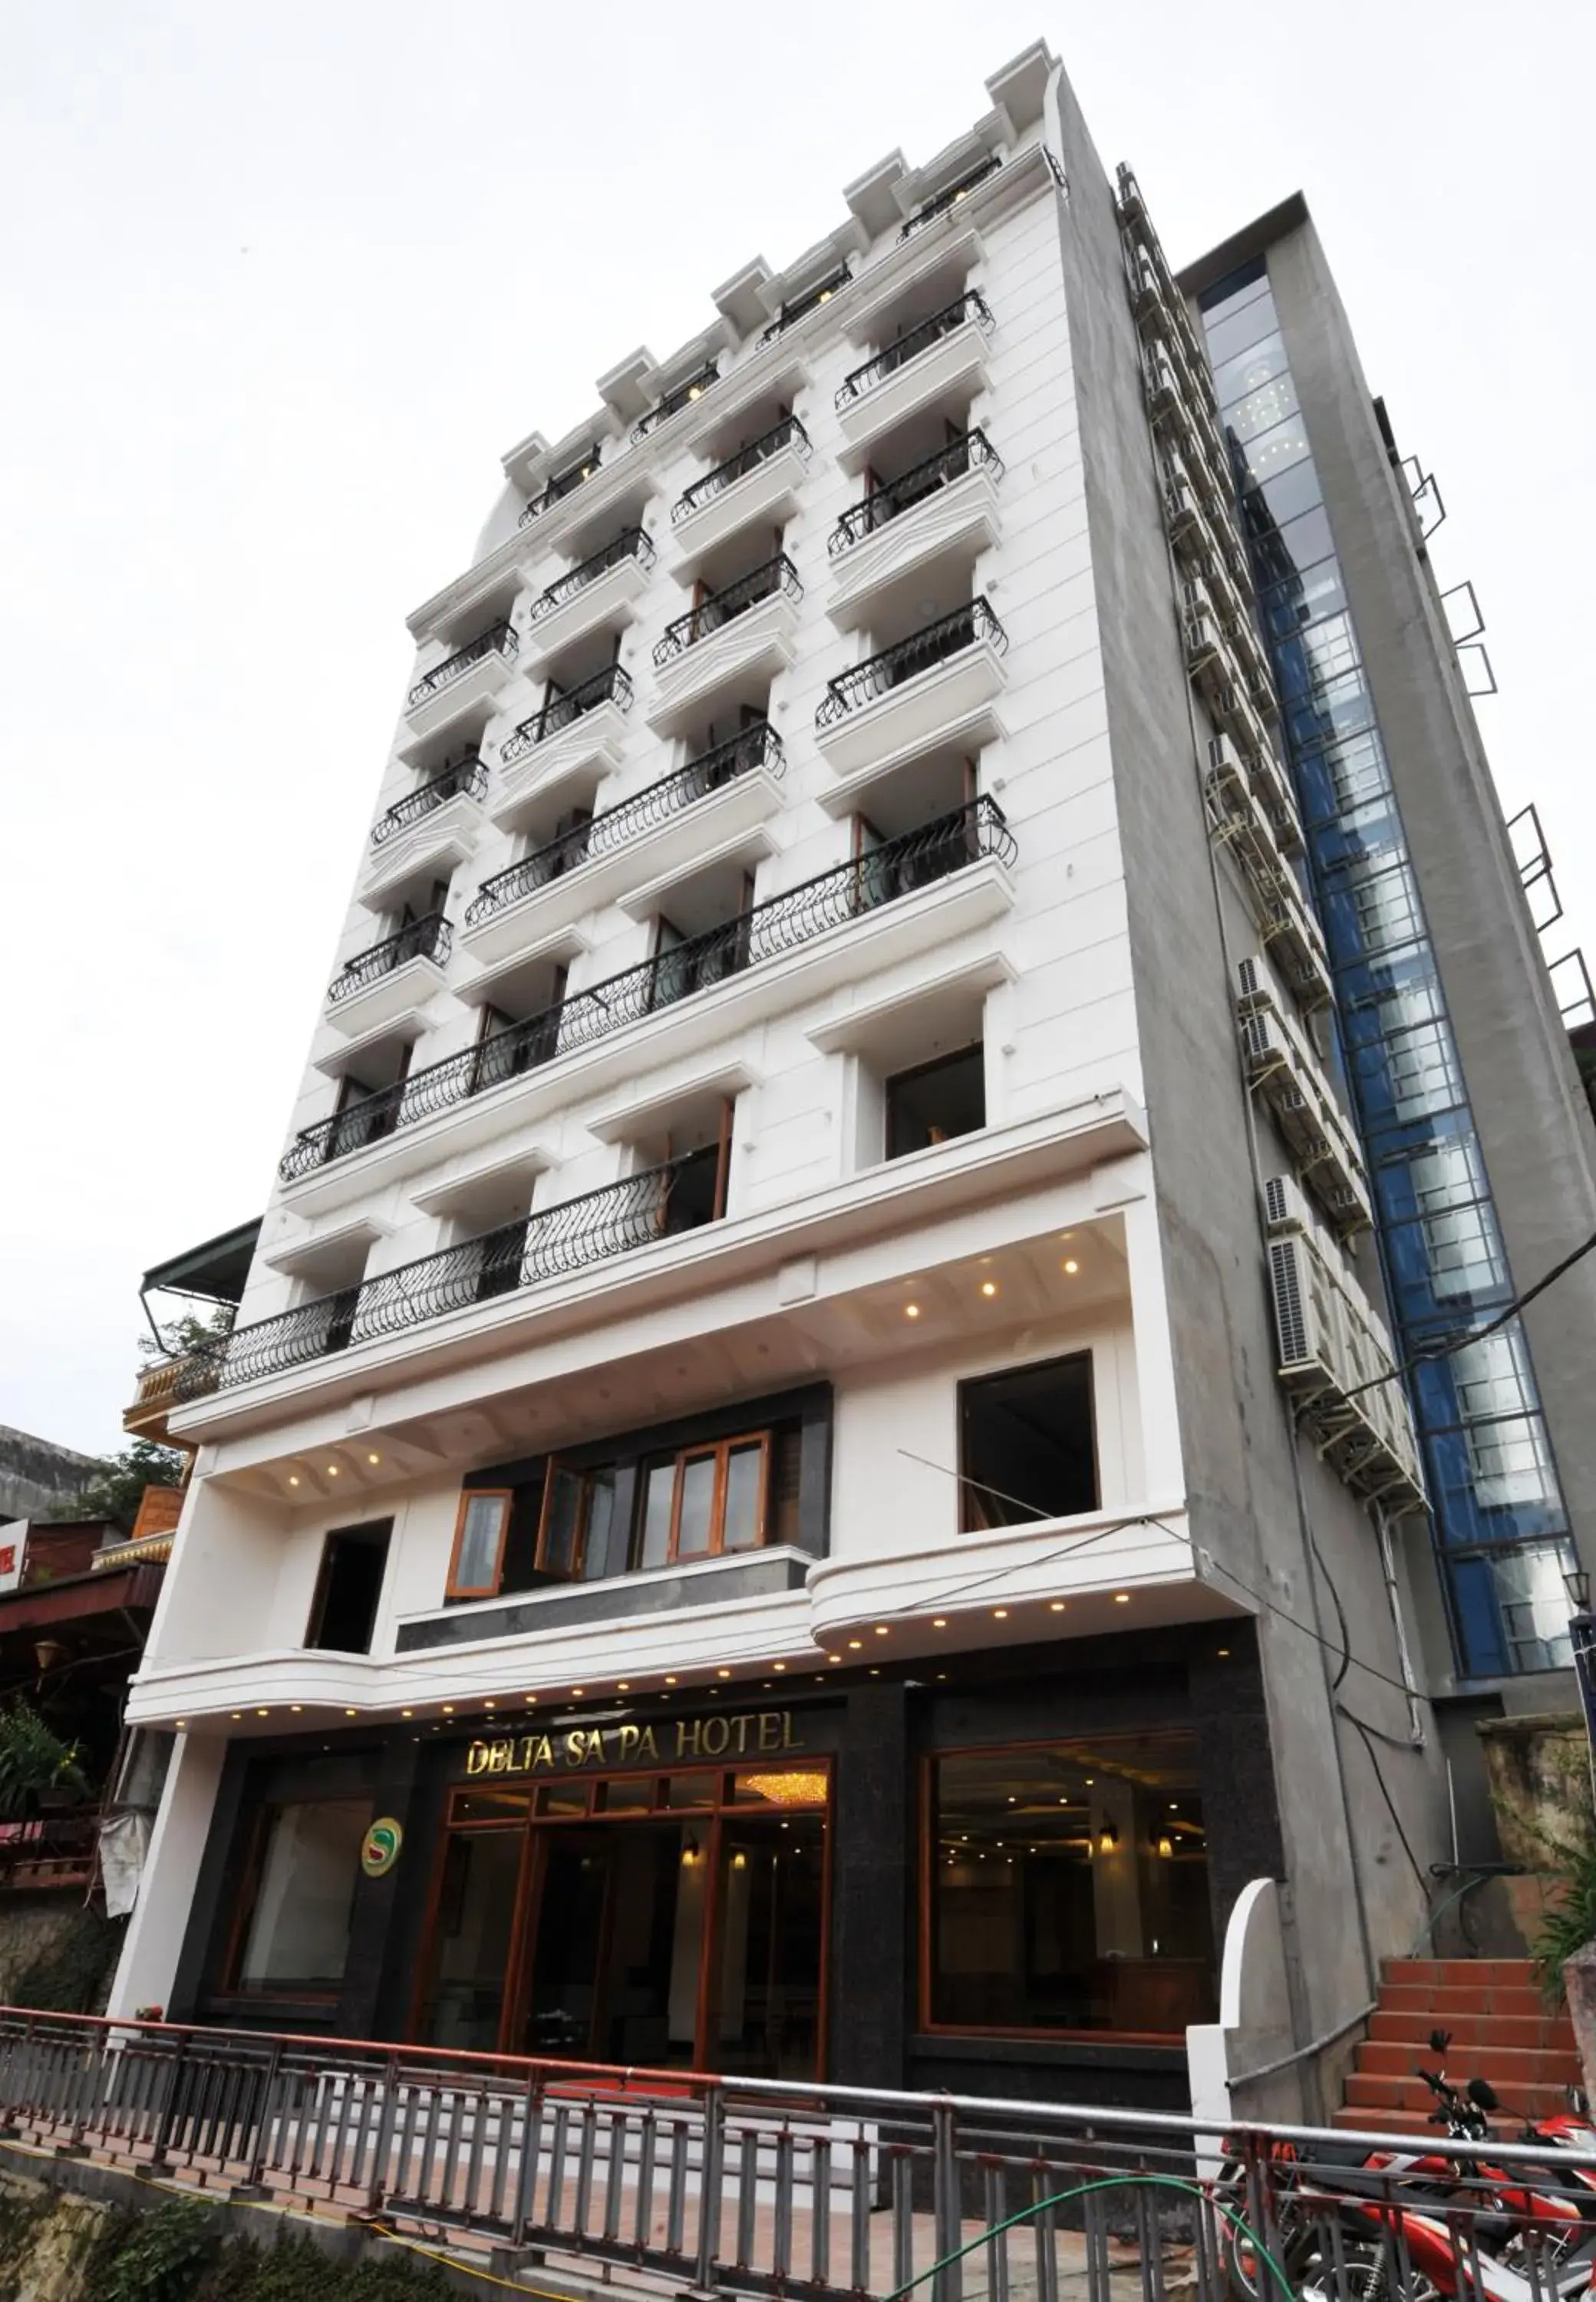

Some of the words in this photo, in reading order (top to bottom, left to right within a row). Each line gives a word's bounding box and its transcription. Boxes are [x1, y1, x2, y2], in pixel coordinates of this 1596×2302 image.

[467, 1733, 554, 1774] DELTA
[566, 1729, 606, 1766] SA
[619, 1725, 659, 1761] PA
[676, 1711, 804, 1756] HOTEL
